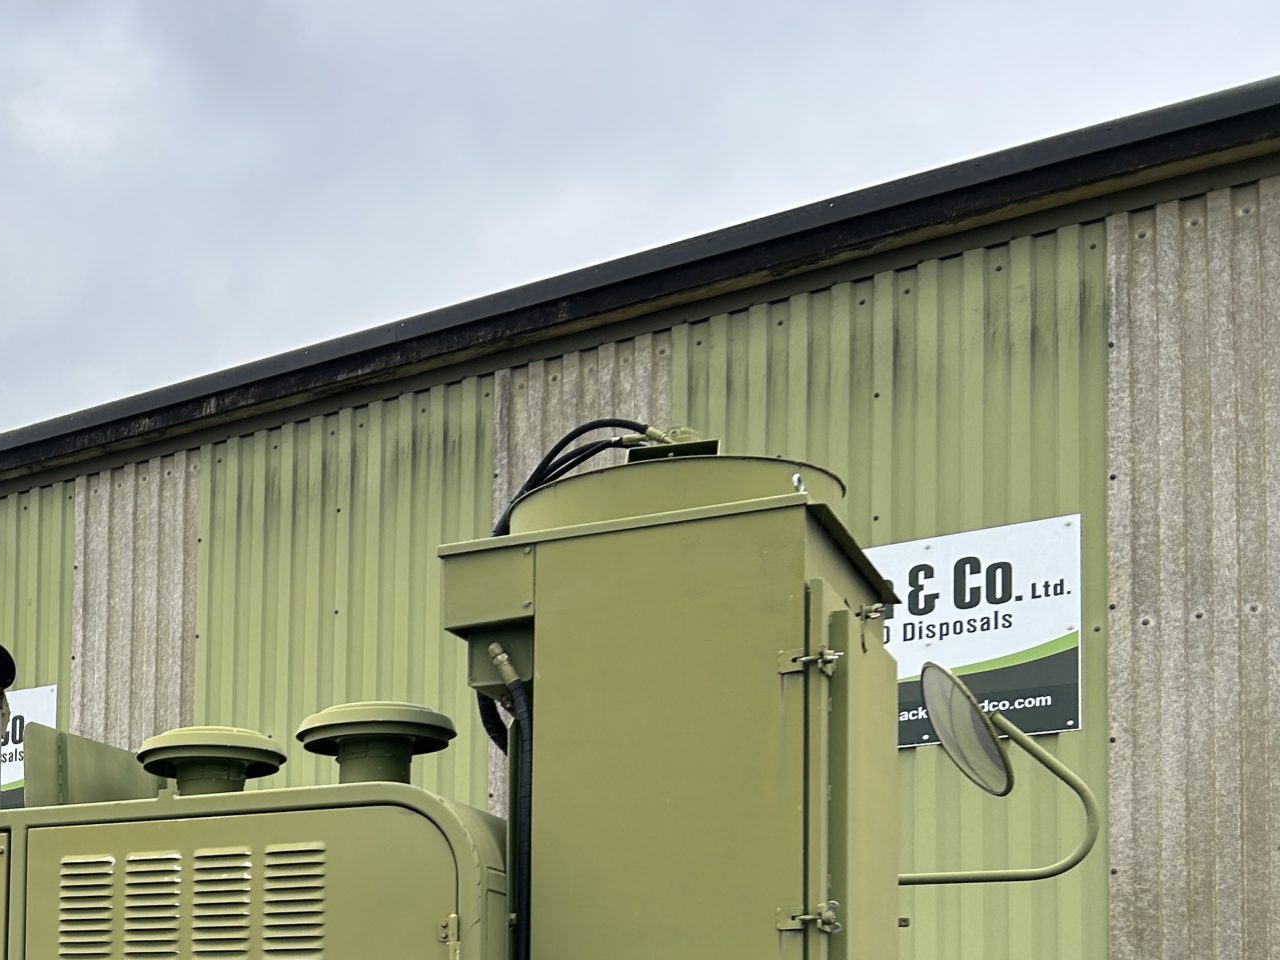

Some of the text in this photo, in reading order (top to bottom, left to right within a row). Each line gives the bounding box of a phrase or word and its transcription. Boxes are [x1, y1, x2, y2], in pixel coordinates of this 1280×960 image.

[907, 563, 940, 617] &
[953, 556, 1023, 610] Co.
[1031, 578, 1072, 600] Ltd.
[903, 611, 1013, 642] Disposals
